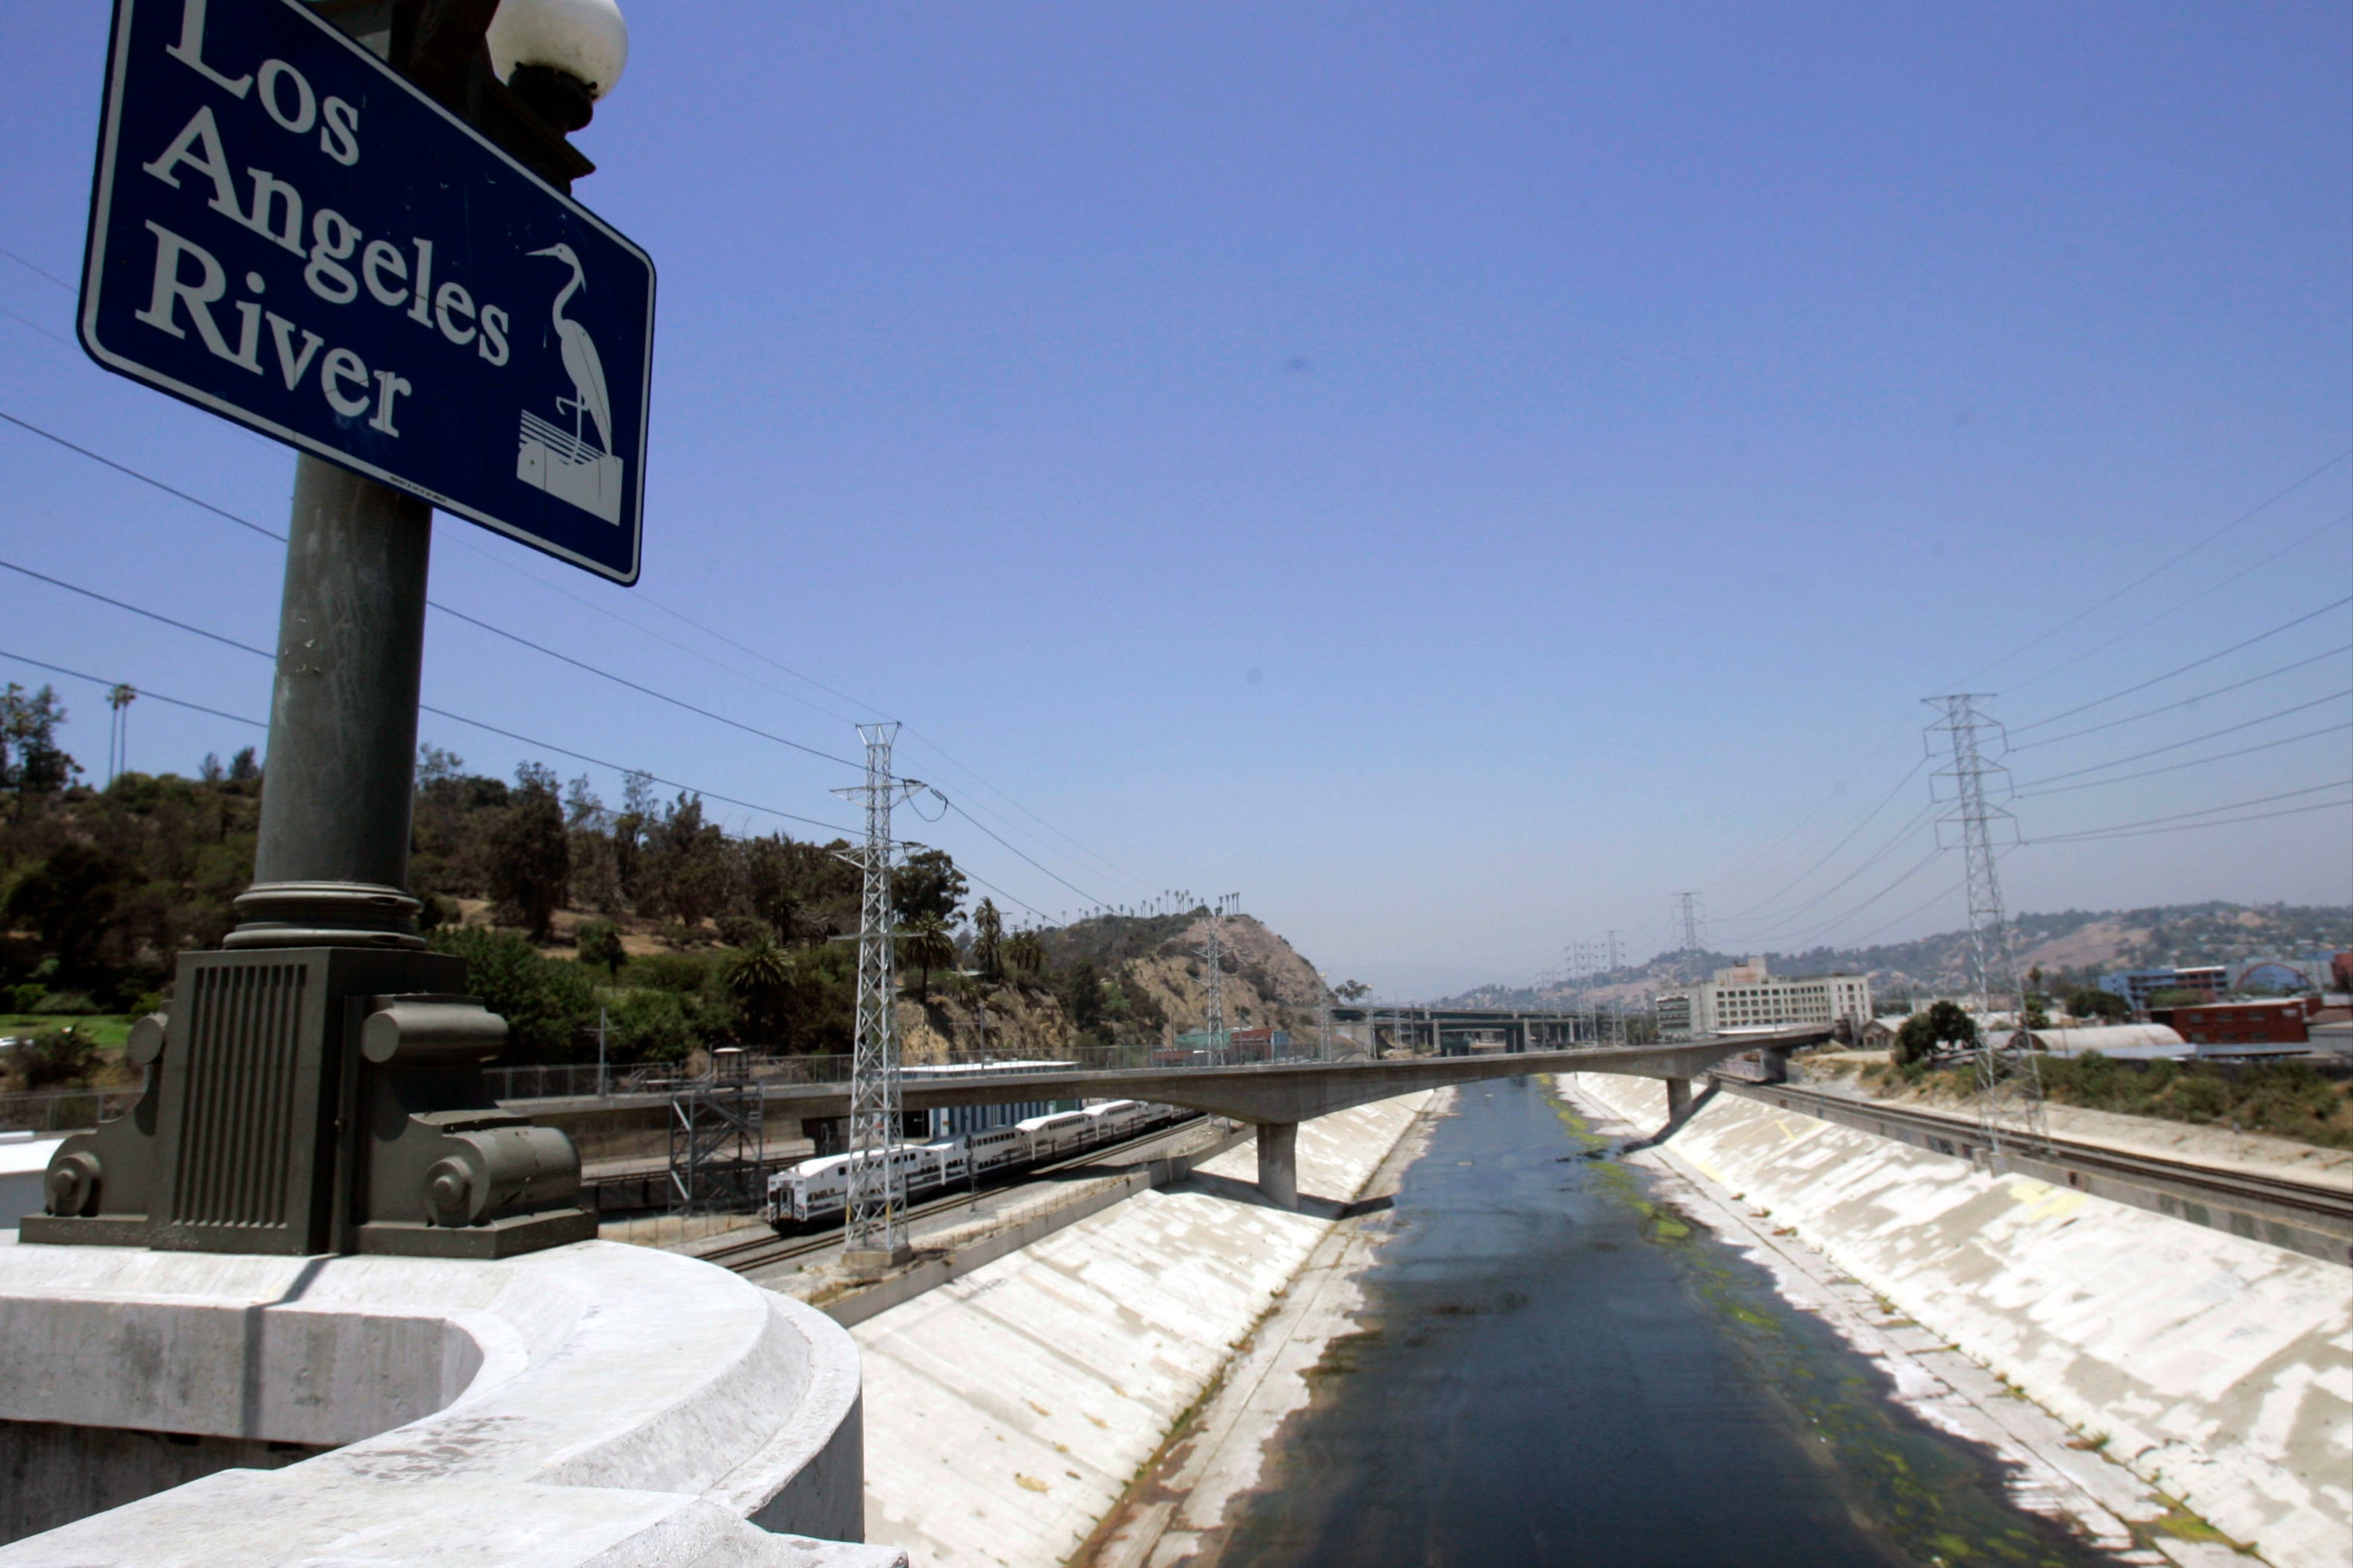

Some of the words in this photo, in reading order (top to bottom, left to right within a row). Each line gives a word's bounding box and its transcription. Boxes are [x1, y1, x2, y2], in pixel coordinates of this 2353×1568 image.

[165, 0, 359, 166] Los
[134, 219, 412, 438] River
[142, 105, 510, 367] Angeles
